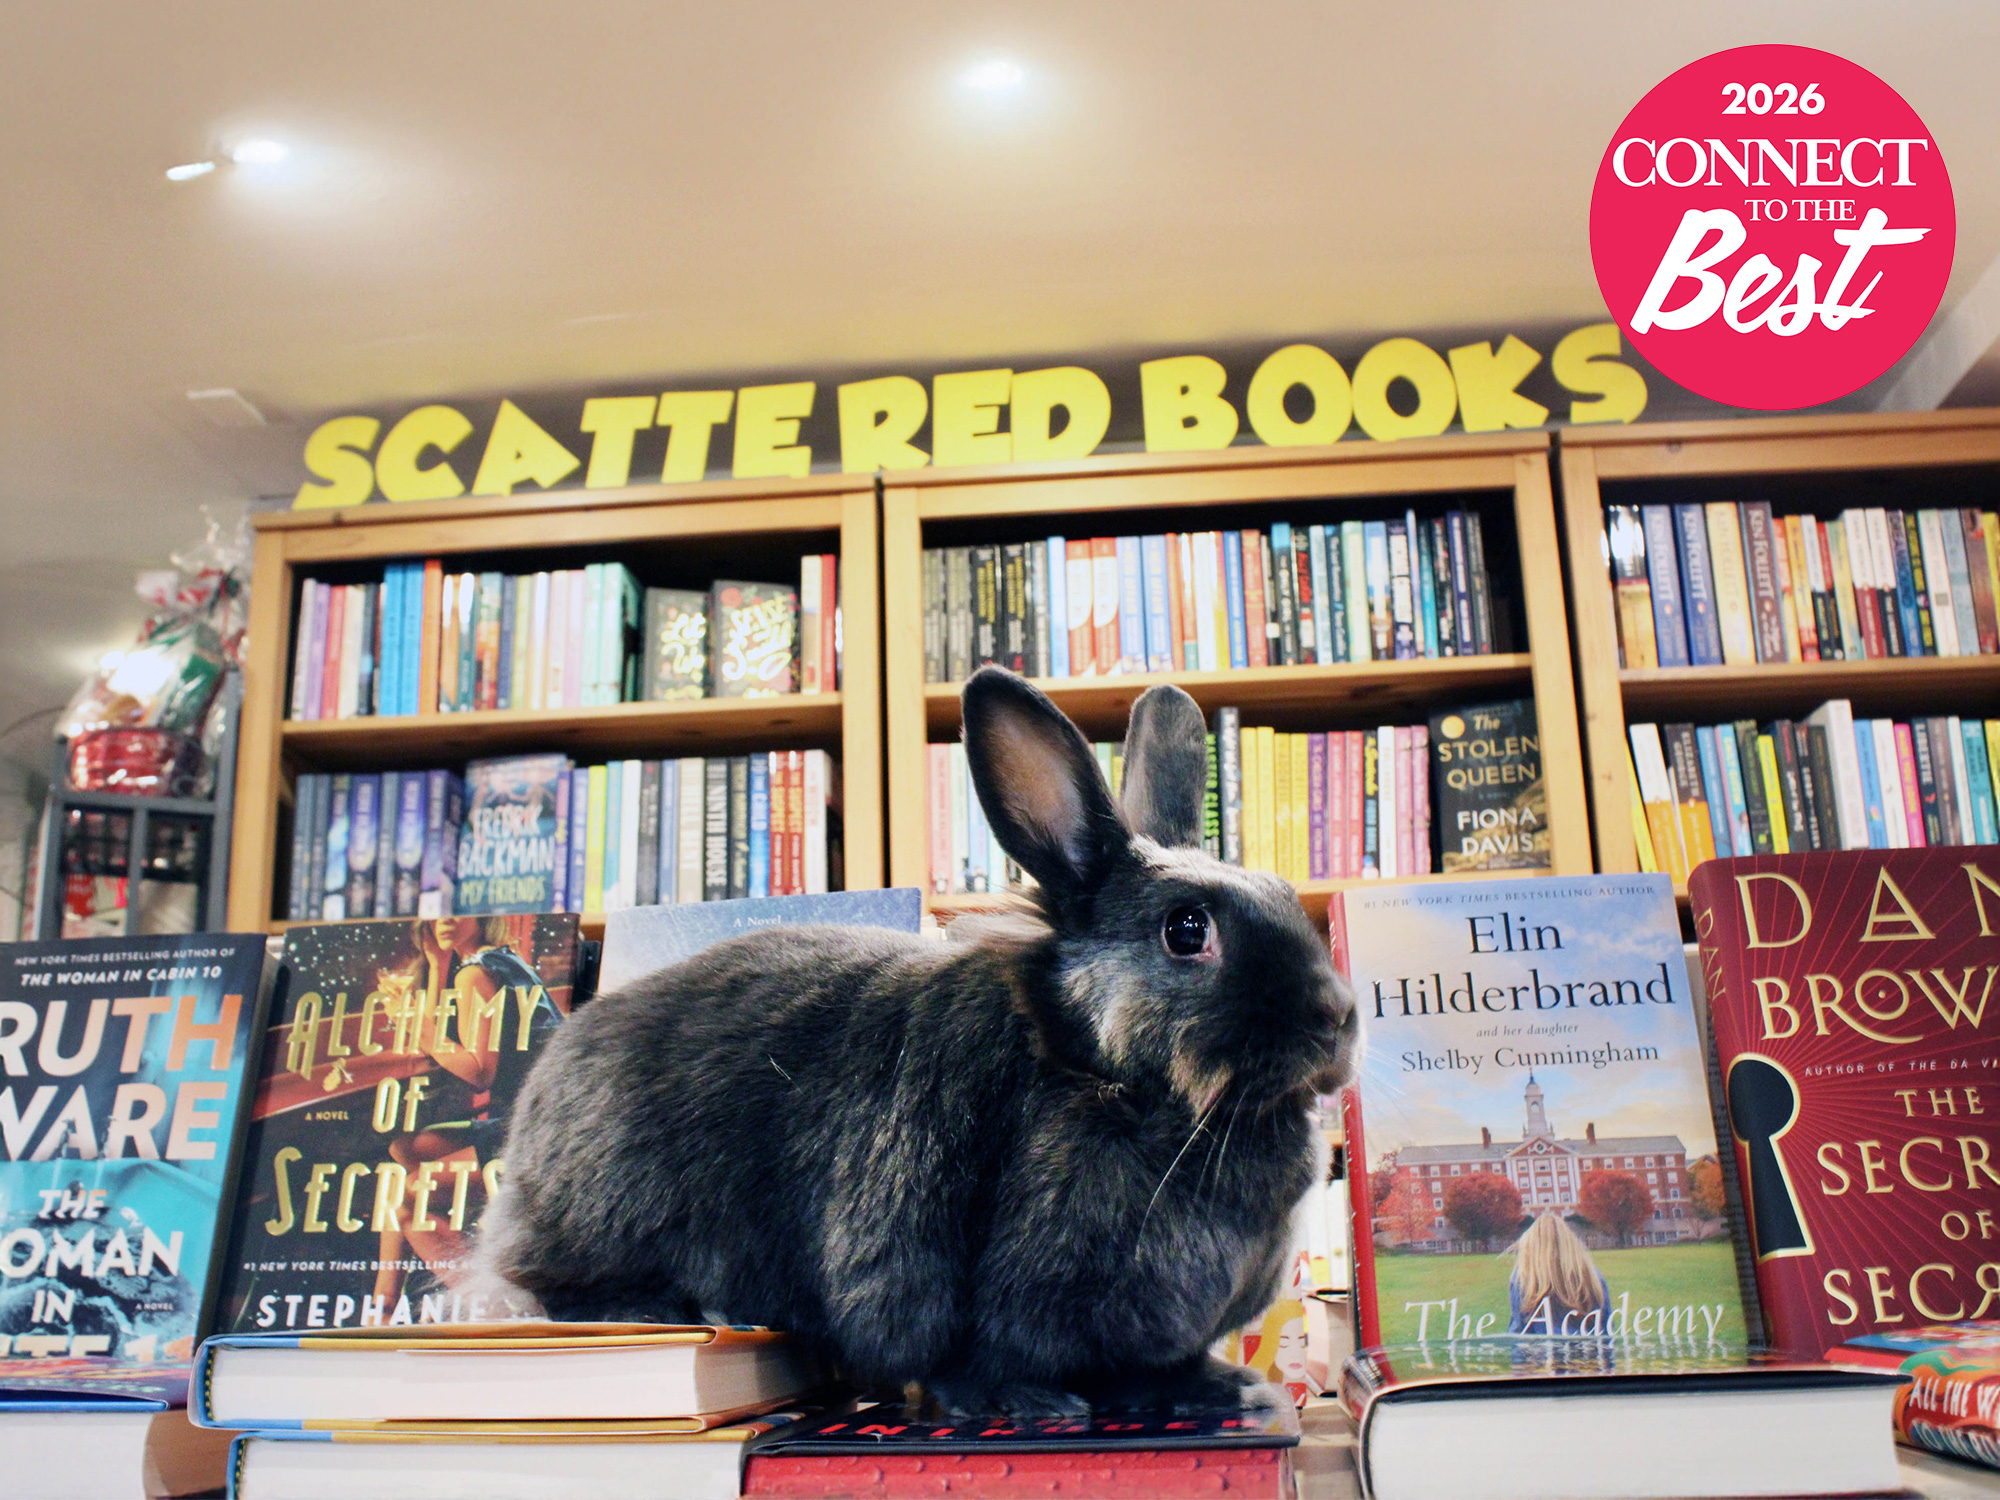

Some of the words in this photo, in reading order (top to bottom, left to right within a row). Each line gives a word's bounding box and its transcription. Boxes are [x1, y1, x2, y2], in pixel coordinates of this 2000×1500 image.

[1141, 323, 1649, 453] BOOKS
[1473, 714, 1500, 732] The
[1437, 735, 1539, 763] STOLEN
[1446, 762, 1537, 791] QUEEN
[1204, 791, 1220, 837] CLASS
[1457, 806, 1537, 831] FIONA
[457, 835, 557, 880] BACKMAN
[1461, 832, 1534, 857] DAVIS
[459, 878, 486, 906] MY
[488, 875, 546, 905] FRIENDS
[1382, 898, 1413, 908] NEW
[1418, 896, 1453, 906] YORK
[1459, 893, 1500, 904] TIMES
[1505, 888, 1593, 901] BESTSELLING
[1598, 885, 1655, 897] AUTHOR
[733, 917, 743, 928] A
[747, 914, 782, 928] Novel
[1466, 912, 1564, 954] Elin
[14, 956, 38, 967] NEW
[40, 954, 67, 965] YORK
[70, 952, 100, 964] TIMES
[102, 950, 170, 962] BESTSELLING
[172, 948, 216, 959] AUTHOR
[219, 947, 236, 958] OF
[20, 973, 51, 987] THE
[56, 970, 120, 985] WOMAN
[123, 969, 143, 982] IN
[146, 966, 196, 981] CABIN
[202, 965, 222, 979] 10
[1371, 963, 1676, 1018] Hilderbrand
[286, 985, 545, 1081] ALCHEMY
[1476, 1026, 1498, 1038] and
[1503, 1024, 1522, 1036] her
[1527, 1023, 1579, 1039] daughter
[1402, 1049, 1484, 1075] Shelby
[1494, 1042, 1660, 1070] Cunningham
[1804, 1063, 1865, 1077] AUTHOR
[1877, 1061, 1895, 1073] OF
[1909, 1060, 1937, 1071] THE
[1950, 1059, 1968, 1070] DA
[305, 1112, 313, 1121] A
[315, 1110, 349, 1121] NOVEL
[372, 1076, 430, 1133] OF
[1894, 1087, 1985, 1118] THE
[38, 1189, 107, 1219] THE
[1940, 1208, 1998, 1241] OF
[259, 1261, 287, 1272] NEW
[291, 1260, 325, 1271] YORK
[329, 1260, 366, 1271] TIMES
[370, 1259, 457, 1271] BESTSELLING
[31, 1290, 75, 1324] IN
[149, 1302, 174, 1311] NOVEL
[1404, 1297, 1496, 1342] The
[1521, 1291, 1725, 1340] Academy
[1908, 1375, 1940, 1412] ALL
[1942, 1379, 1973, 1418] THE
